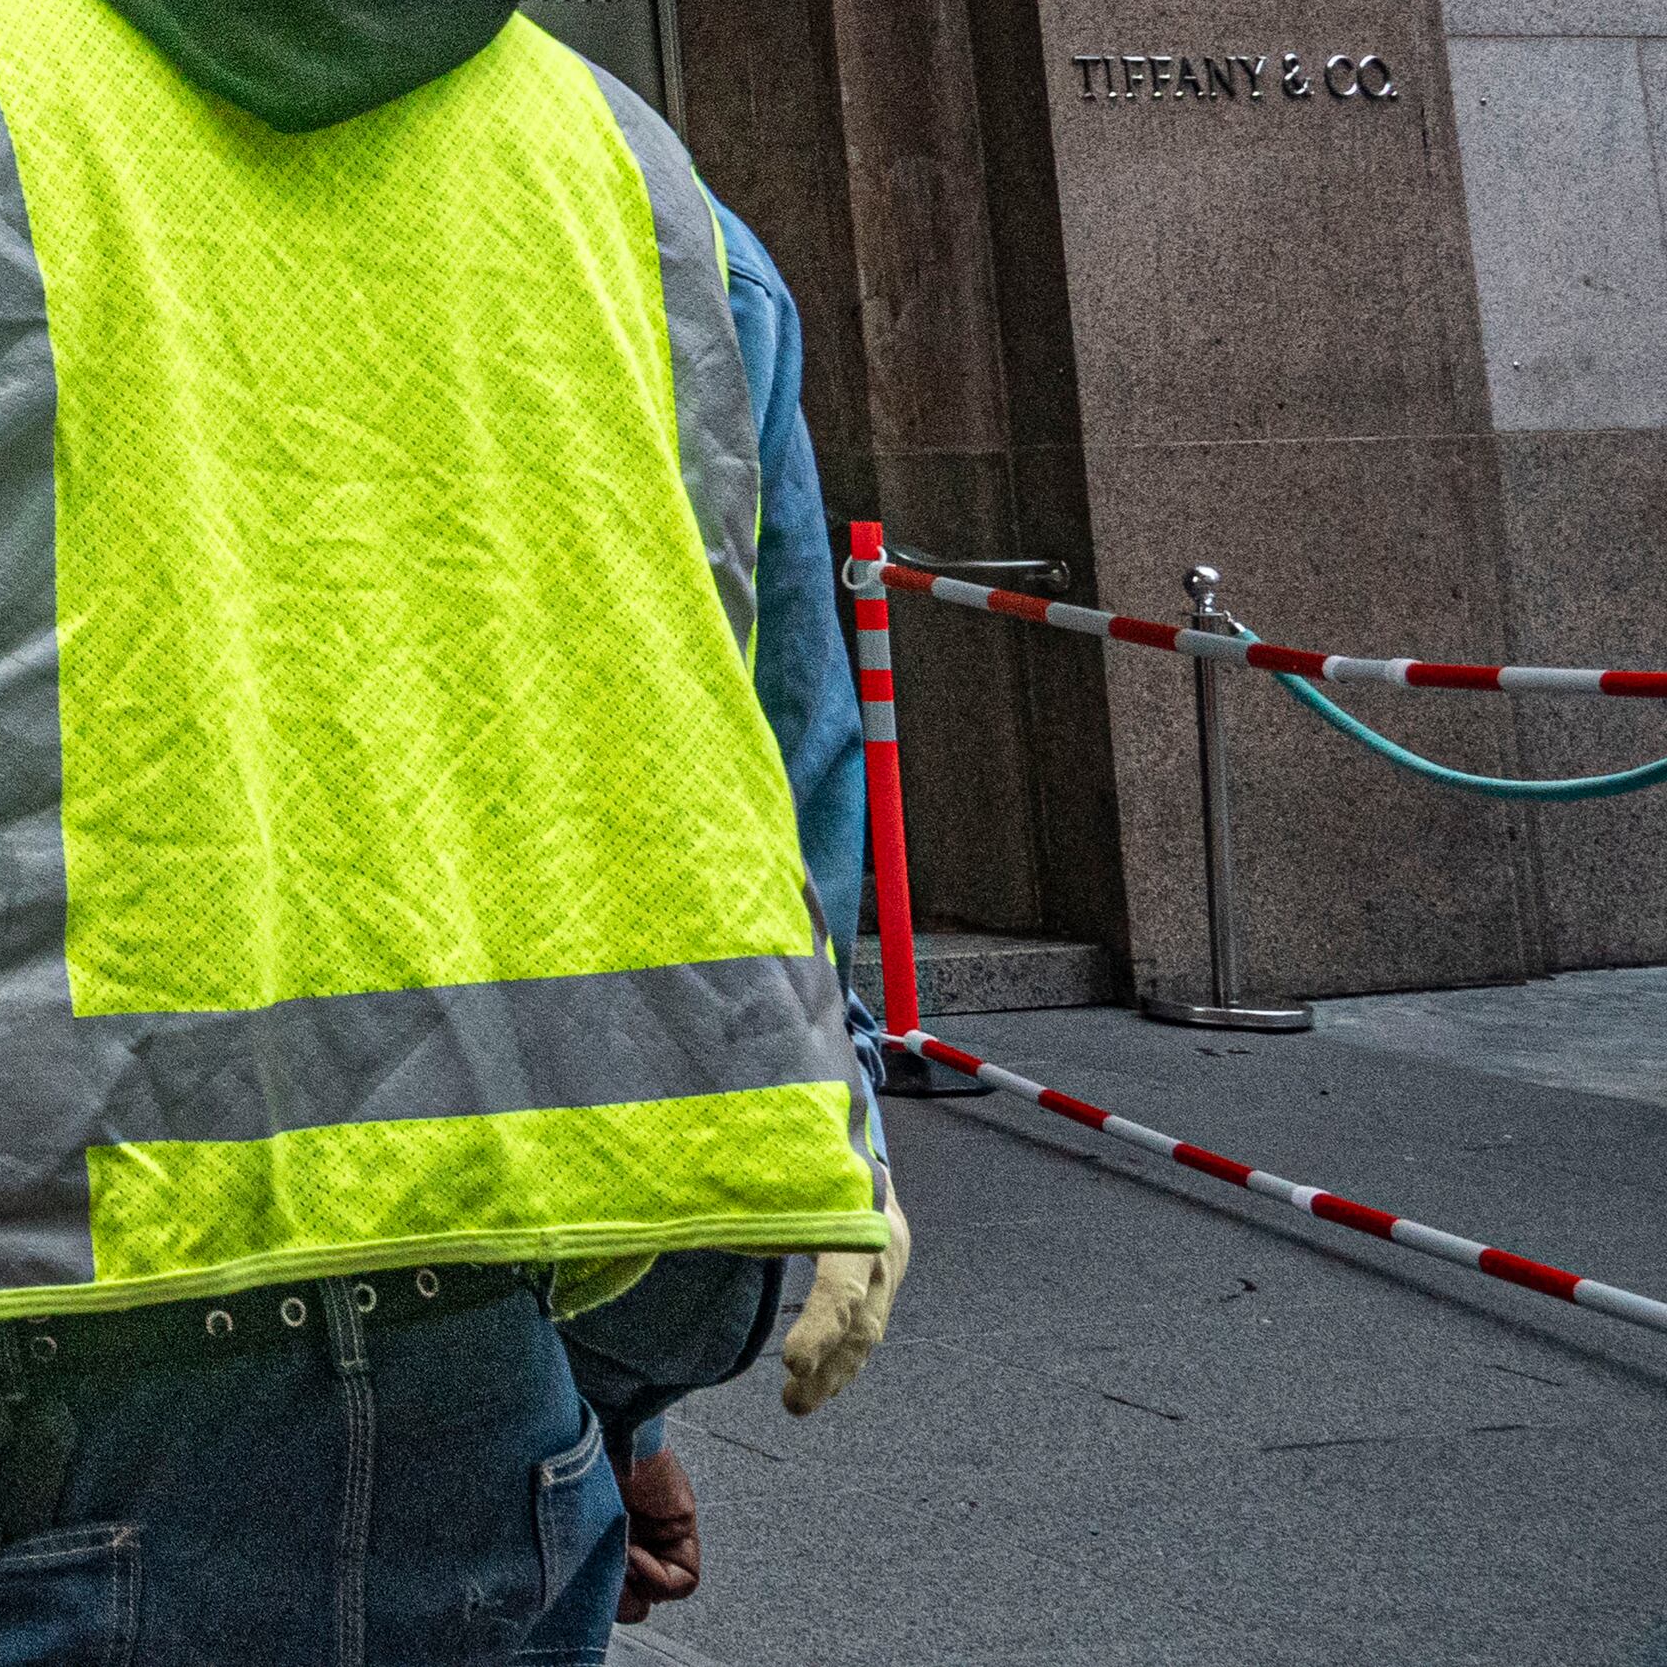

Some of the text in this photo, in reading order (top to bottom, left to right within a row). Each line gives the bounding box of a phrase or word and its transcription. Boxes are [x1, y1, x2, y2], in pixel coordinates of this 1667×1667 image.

[1072, 52, 1399, 99] TIFFANY & CO.
